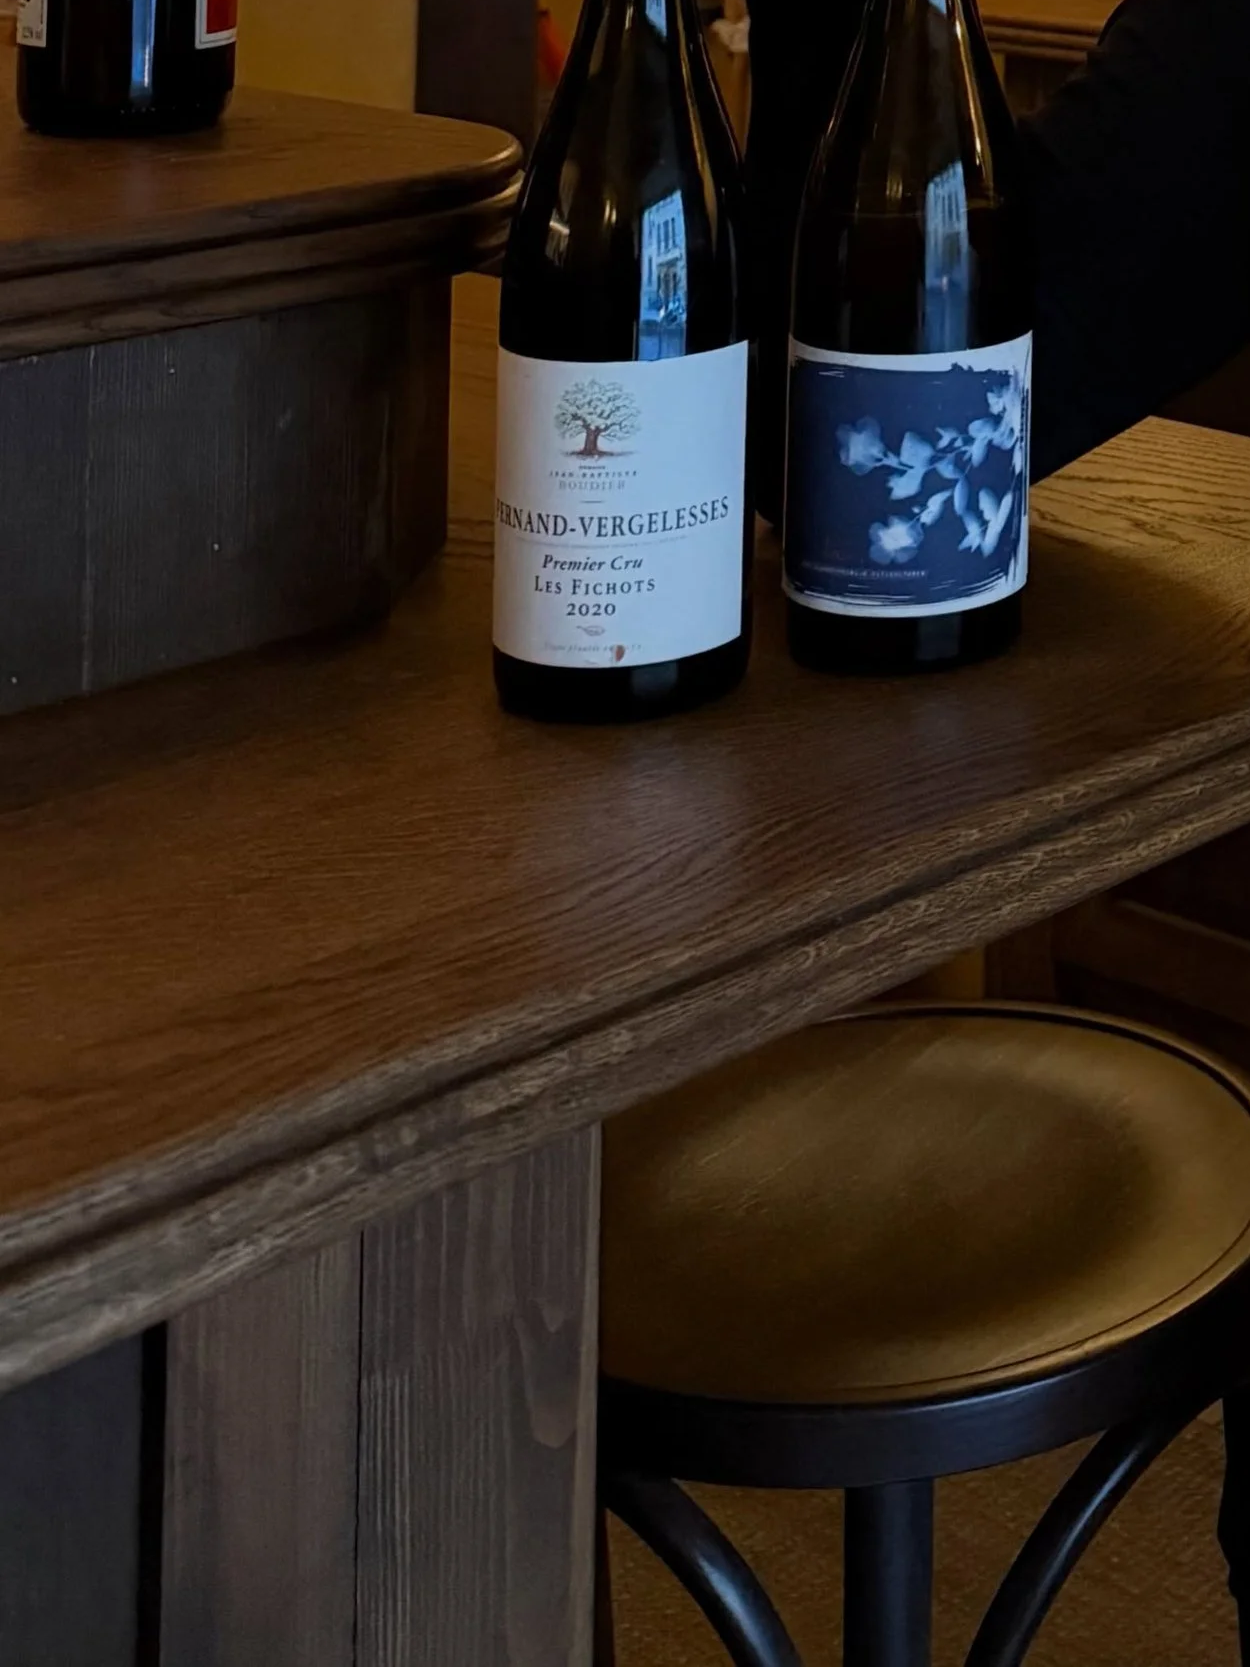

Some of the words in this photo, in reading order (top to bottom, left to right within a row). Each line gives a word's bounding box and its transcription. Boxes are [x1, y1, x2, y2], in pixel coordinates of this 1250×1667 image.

[542, 554, 606, 572] Premier
[610, 555, 644, 571] Cru
[565, 602, 616, 617] 2020
